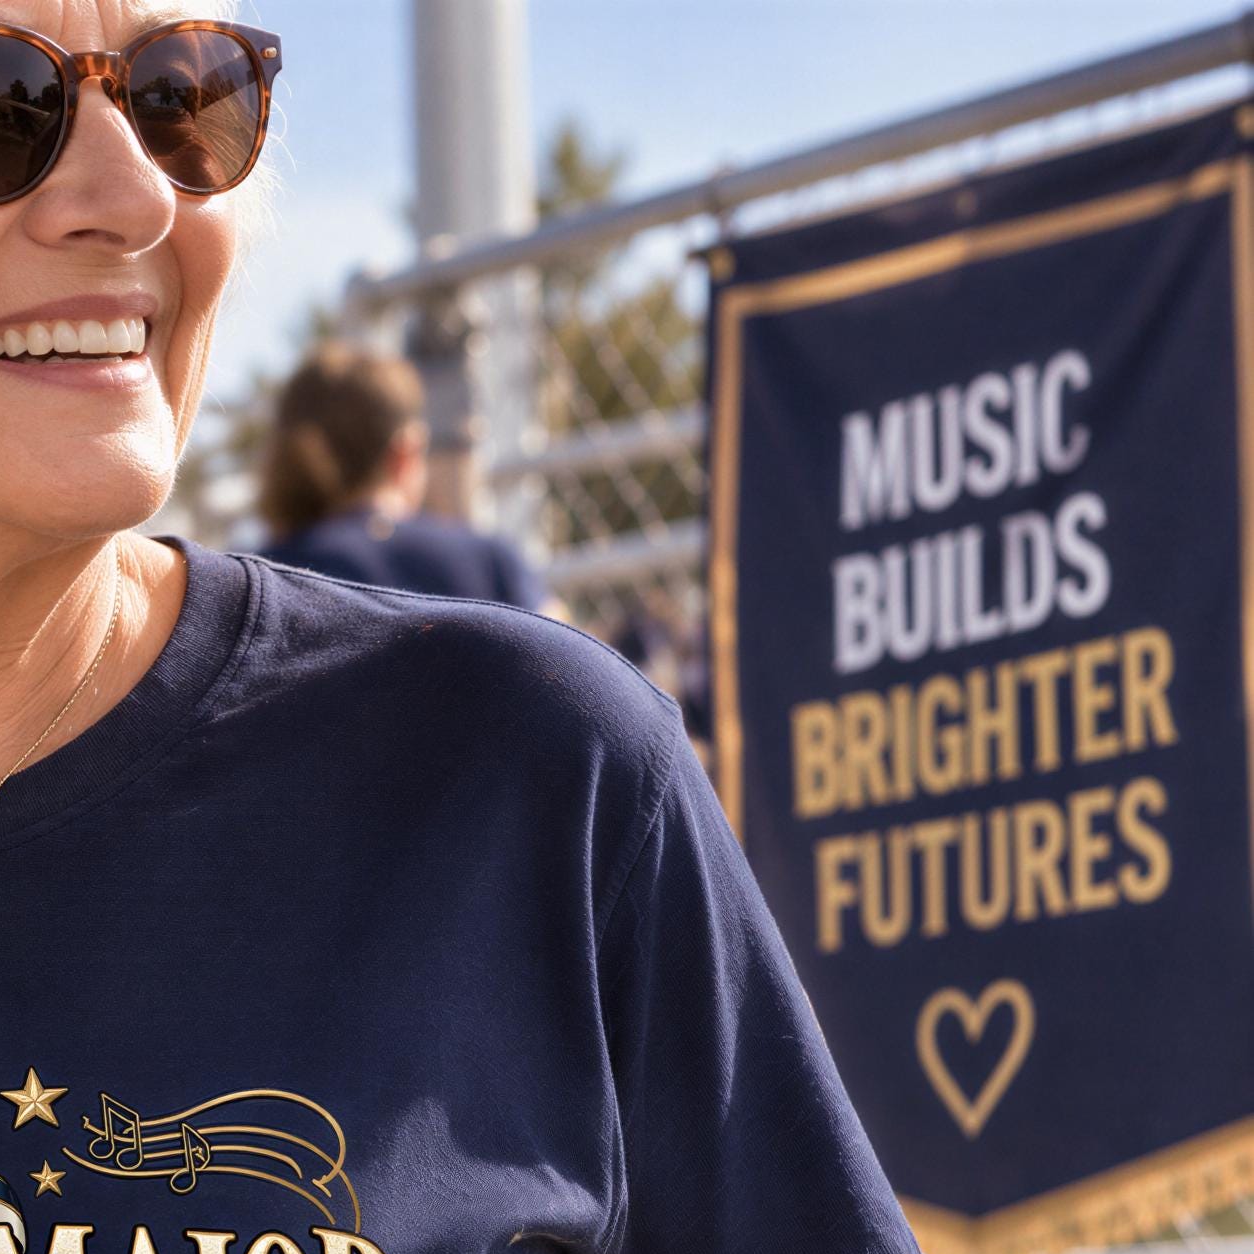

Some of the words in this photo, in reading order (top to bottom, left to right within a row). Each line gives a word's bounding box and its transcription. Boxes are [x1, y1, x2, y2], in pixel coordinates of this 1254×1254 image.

[839, 348, 1092, 531] MUSIC
[832, 491, 1112, 675] BUILDS
[791, 626, 1179, 820] BRIGHTER
[814, 777, 1173, 954] FUTURES
